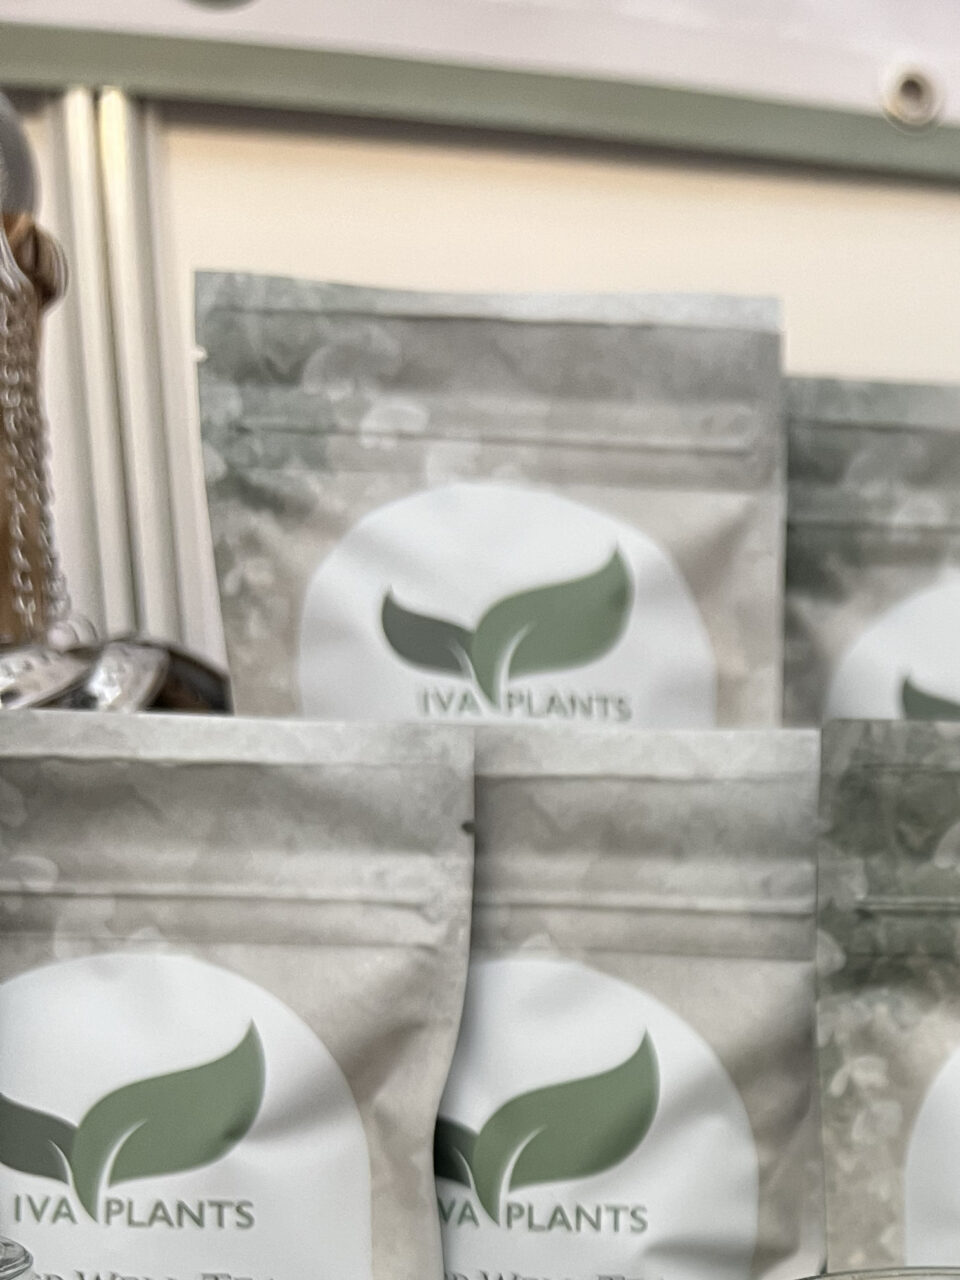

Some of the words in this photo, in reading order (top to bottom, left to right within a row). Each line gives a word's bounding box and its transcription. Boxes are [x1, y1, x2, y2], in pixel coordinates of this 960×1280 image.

[423, 689, 478, 717] IVA
[507, 690, 632, 722] PLANTS
[14, 1194, 76, 1224] IVA
[105, 1199, 255, 1230] PLANTS
[506, 1202, 648, 1233] PLANTS
